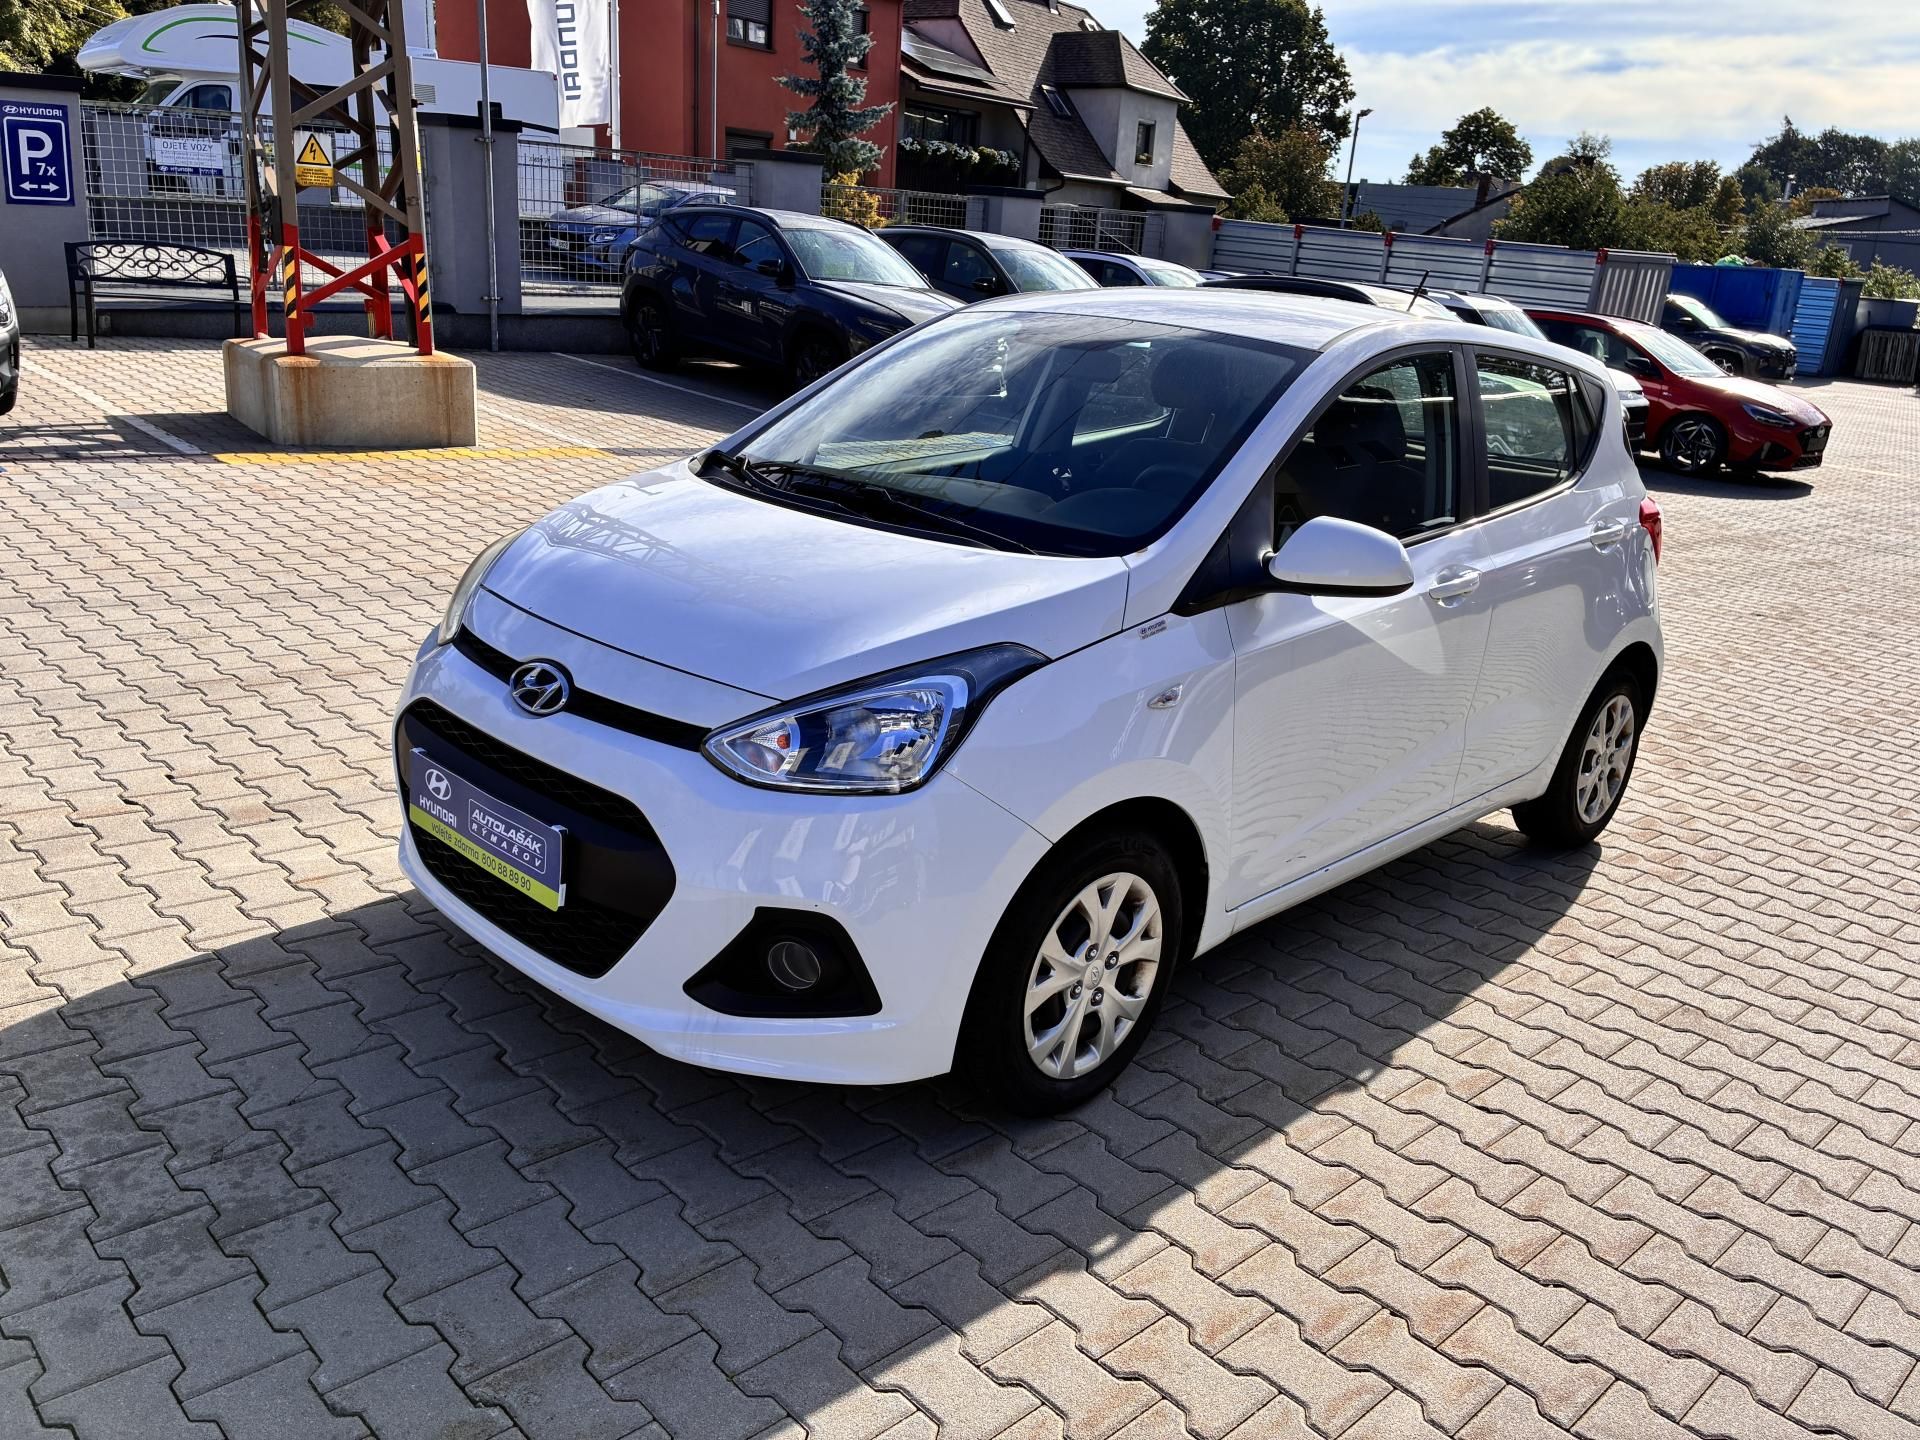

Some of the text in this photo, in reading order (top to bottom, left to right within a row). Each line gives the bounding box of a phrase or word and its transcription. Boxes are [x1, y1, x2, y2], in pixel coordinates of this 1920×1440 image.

[19, 106, 63, 117] HYUNDAI
[18, 128, 53, 175] P
[191, 143, 213, 152] VOZY
[36, 162, 57, 177] 7x
[419, 794, 457, 829] HYUNDAI
[471, 808, 543, 854] AUTOLAŠÁK
[431, 822, 531, 891] volejte zdarma 800 88 89 90
[471, 822, 542, 867] RÝMAŘOV
